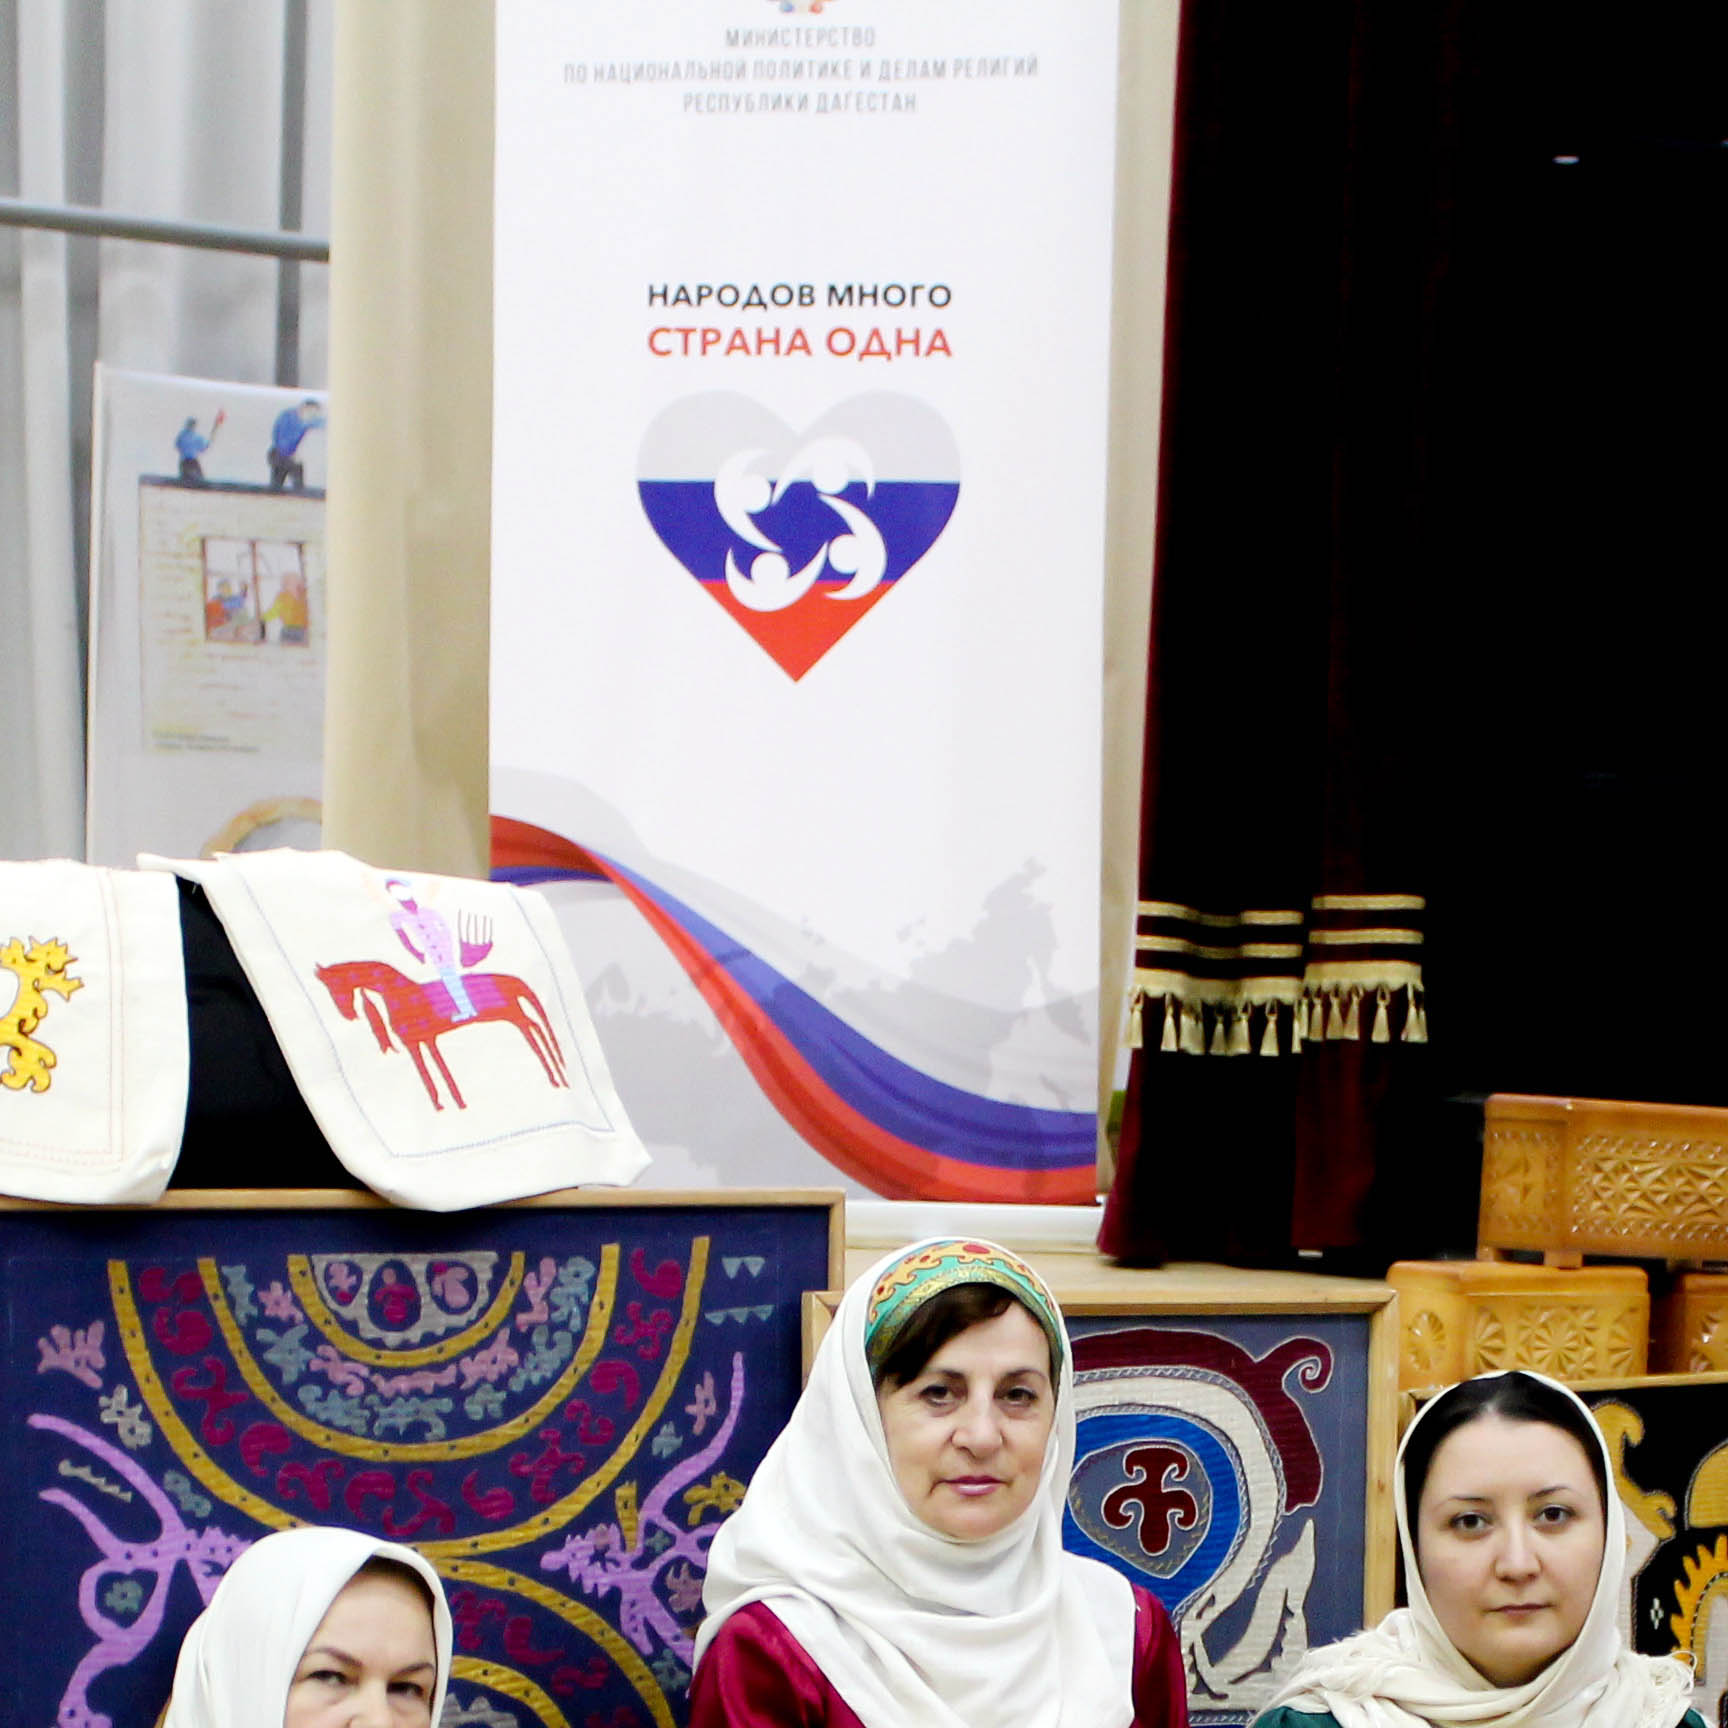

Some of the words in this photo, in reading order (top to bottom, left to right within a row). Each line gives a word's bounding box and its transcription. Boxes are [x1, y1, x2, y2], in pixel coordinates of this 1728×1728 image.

[726, 27, 876, 48] МИНИСТЕРСТВО
[564, 62, 588, 84] ПО
[594, 57, 747, 85] НАЦИОНАЛЬНОЙ
[753, 58, 852, 81] ПОЛИТИКЕ
[860, 59, 872, 78] И
[878, 57, 947, 82] ДЕЛАМ
[952, 53, 1039, 79] РЕЛИГИЙ
[683, 92, 809, 113] РЕСПУБЛИКИ
[816, 92, 917, 114] ДАГЕСТАН
[648, 283, 816, 310] НАРОДОВ
[828, 284, 953, 307] МНОГО
[648, 327, 813, 358] СТРАНА
[826, 327, 954, 361] ОДНА
